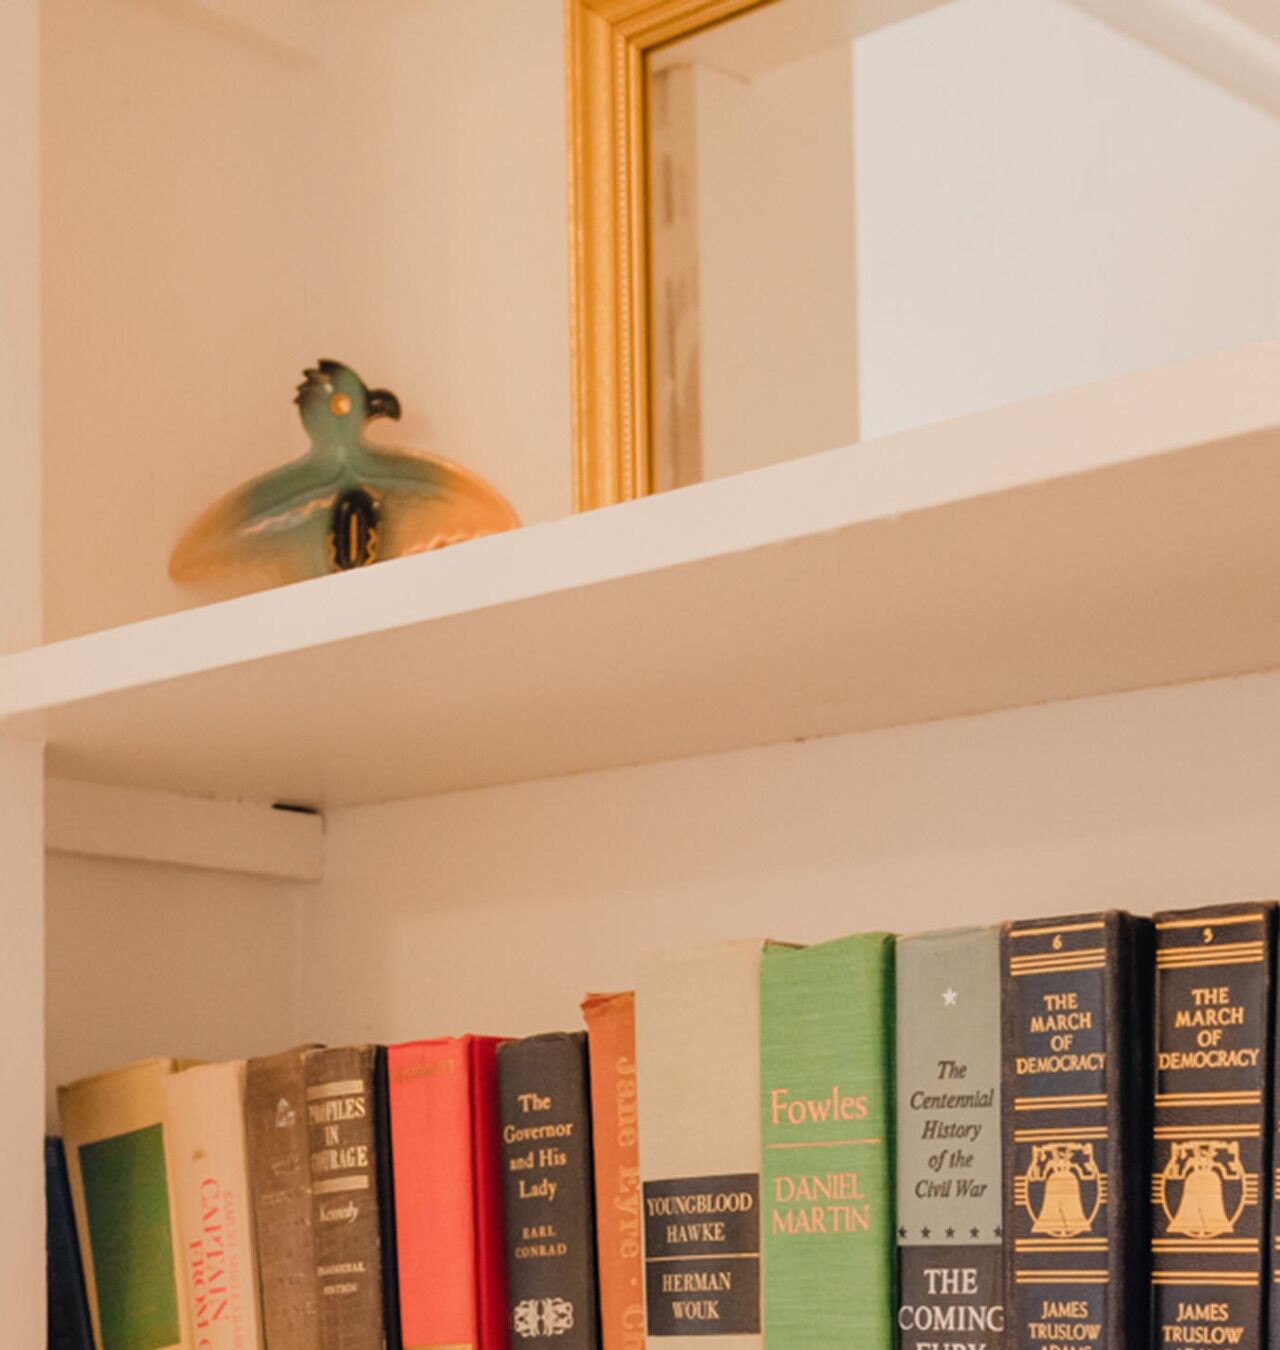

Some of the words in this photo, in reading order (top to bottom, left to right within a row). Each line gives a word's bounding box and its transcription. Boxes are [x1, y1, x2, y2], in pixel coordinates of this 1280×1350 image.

[1043, 992, 1078, 1011] THE
[1191, 986, 1230, 1006] THE
[1030, 1012, 1092, 1033] MARCH
[1174, 1006, 1245, 1029] MARCH
[1050, 1034, 1073, 1052] OF
[1196, 1029, 1223, 1048] OF
[936, 1060, 968, 1080] The
[1016, 1053, 1106, 1075] DEMOCRACY
[1158, 1048, 1260, 1071] DEMOCRACY
[518, 1093, 551, 1113] The
[615, 1056, 637, 1148] Jane
[771, 1085, 868, 1125] Fowles
[910, 1089, 995, 1110] Centennial
[503, 1121, 573, 1144] Governor
[922, 1120, 982, 1142] History
[509, 1151, 534, 1172] and
[539, 1147, 567, 1168] His
[928, 1150, 946, 1173] of
[949, 1149, 974, 1168] the
[519, 1179, 558, 1201] Lady
[775, 1172, 865, 1202] DANIEL
[914, 1179, 952, 1199] Civil
[956, 1179, 988, 1198] War
[646, 1192, 753, 1217] YOUNGBLOOD
[615, 1173, 640, 1260] Eyre
[771, 1204, 870, 1235] MARTIN
[522, 1225, 556, 1240] EARL
[666, 1222, 726, 1243] HAWKE
[200, 1177, 229, 1322] CAPTAIN
[514, 1244, 568, 1260] CONRAD
[189, 1240, 210, 1329] FROM
[662, 1271, 732, 1292] HERMAN
[923, 1268, 978, 1295] THE
[671, 1301, 720, 1321] WOUK
[898, 1305, 1005, 1332] COMING
[1041, 1301, 1088, 1320] JAMES
[1176, 1302, 1229, 1323] JAMES
[1028, 1323, 1101, 1341] TRUSLOW
[1162, 1325, 1244, 1345] TRUSLOW
